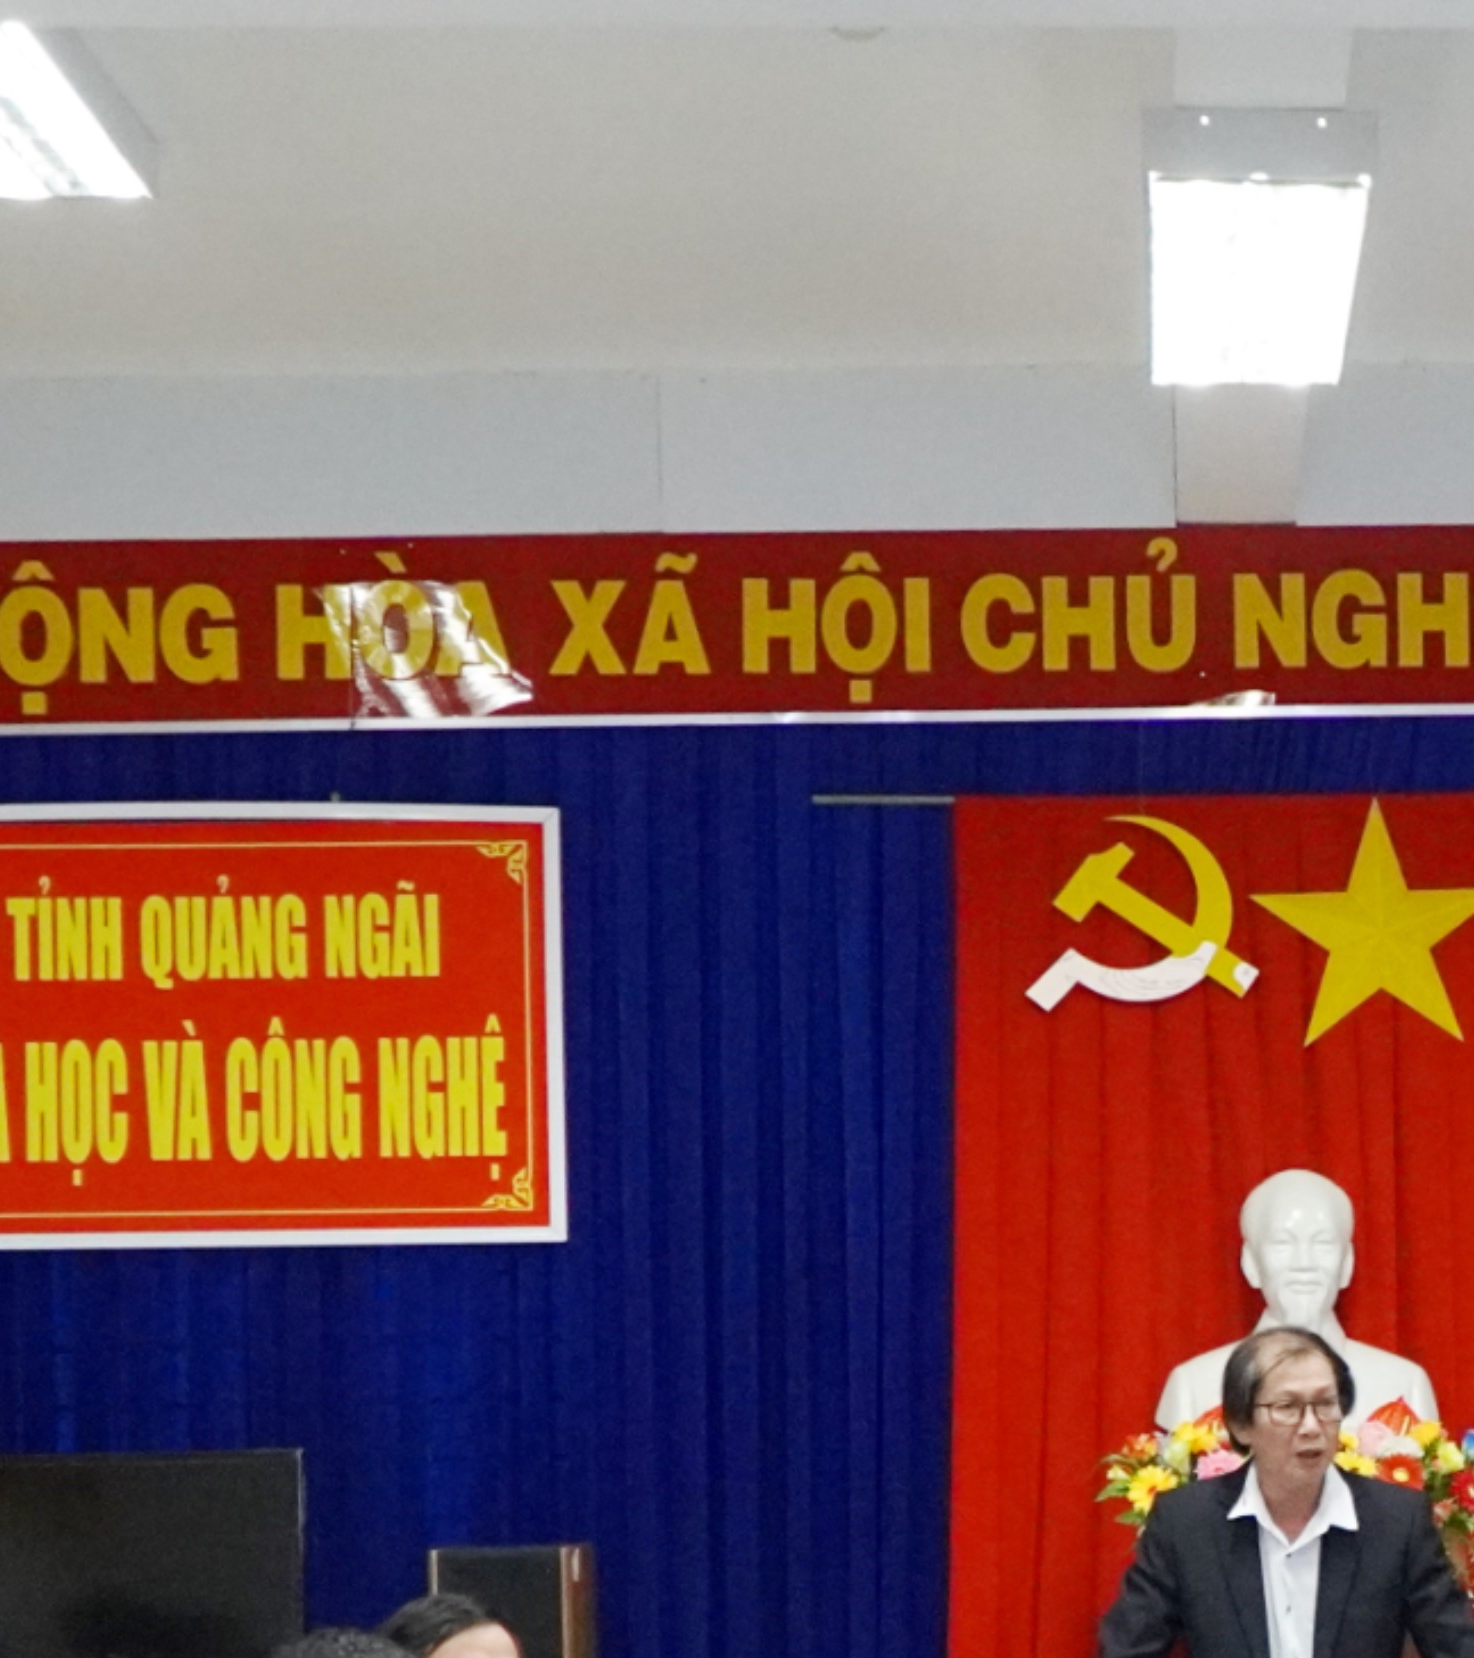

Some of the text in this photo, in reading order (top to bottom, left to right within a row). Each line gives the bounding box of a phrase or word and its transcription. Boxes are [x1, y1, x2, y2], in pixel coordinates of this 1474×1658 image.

[275, 551, 511, 682] HÒA
[548, 552, 712, 676] XÃ
[741, 551, 932, 704] HỘI
[960, 536, 1197, 673] CHỦ
[5, 875, 124, 983] TỈNH
[139, 874, 309, 990] QUẢNG
[323, 880, 441, 980] NGÃI
[24, 1037, 130, 1187] HỌC
[141, 1018, 213, 1162] VÀ
[225, 1015, 364, 1163] CÔNG
[376, 1012, 508, 1181] NGHỆ
